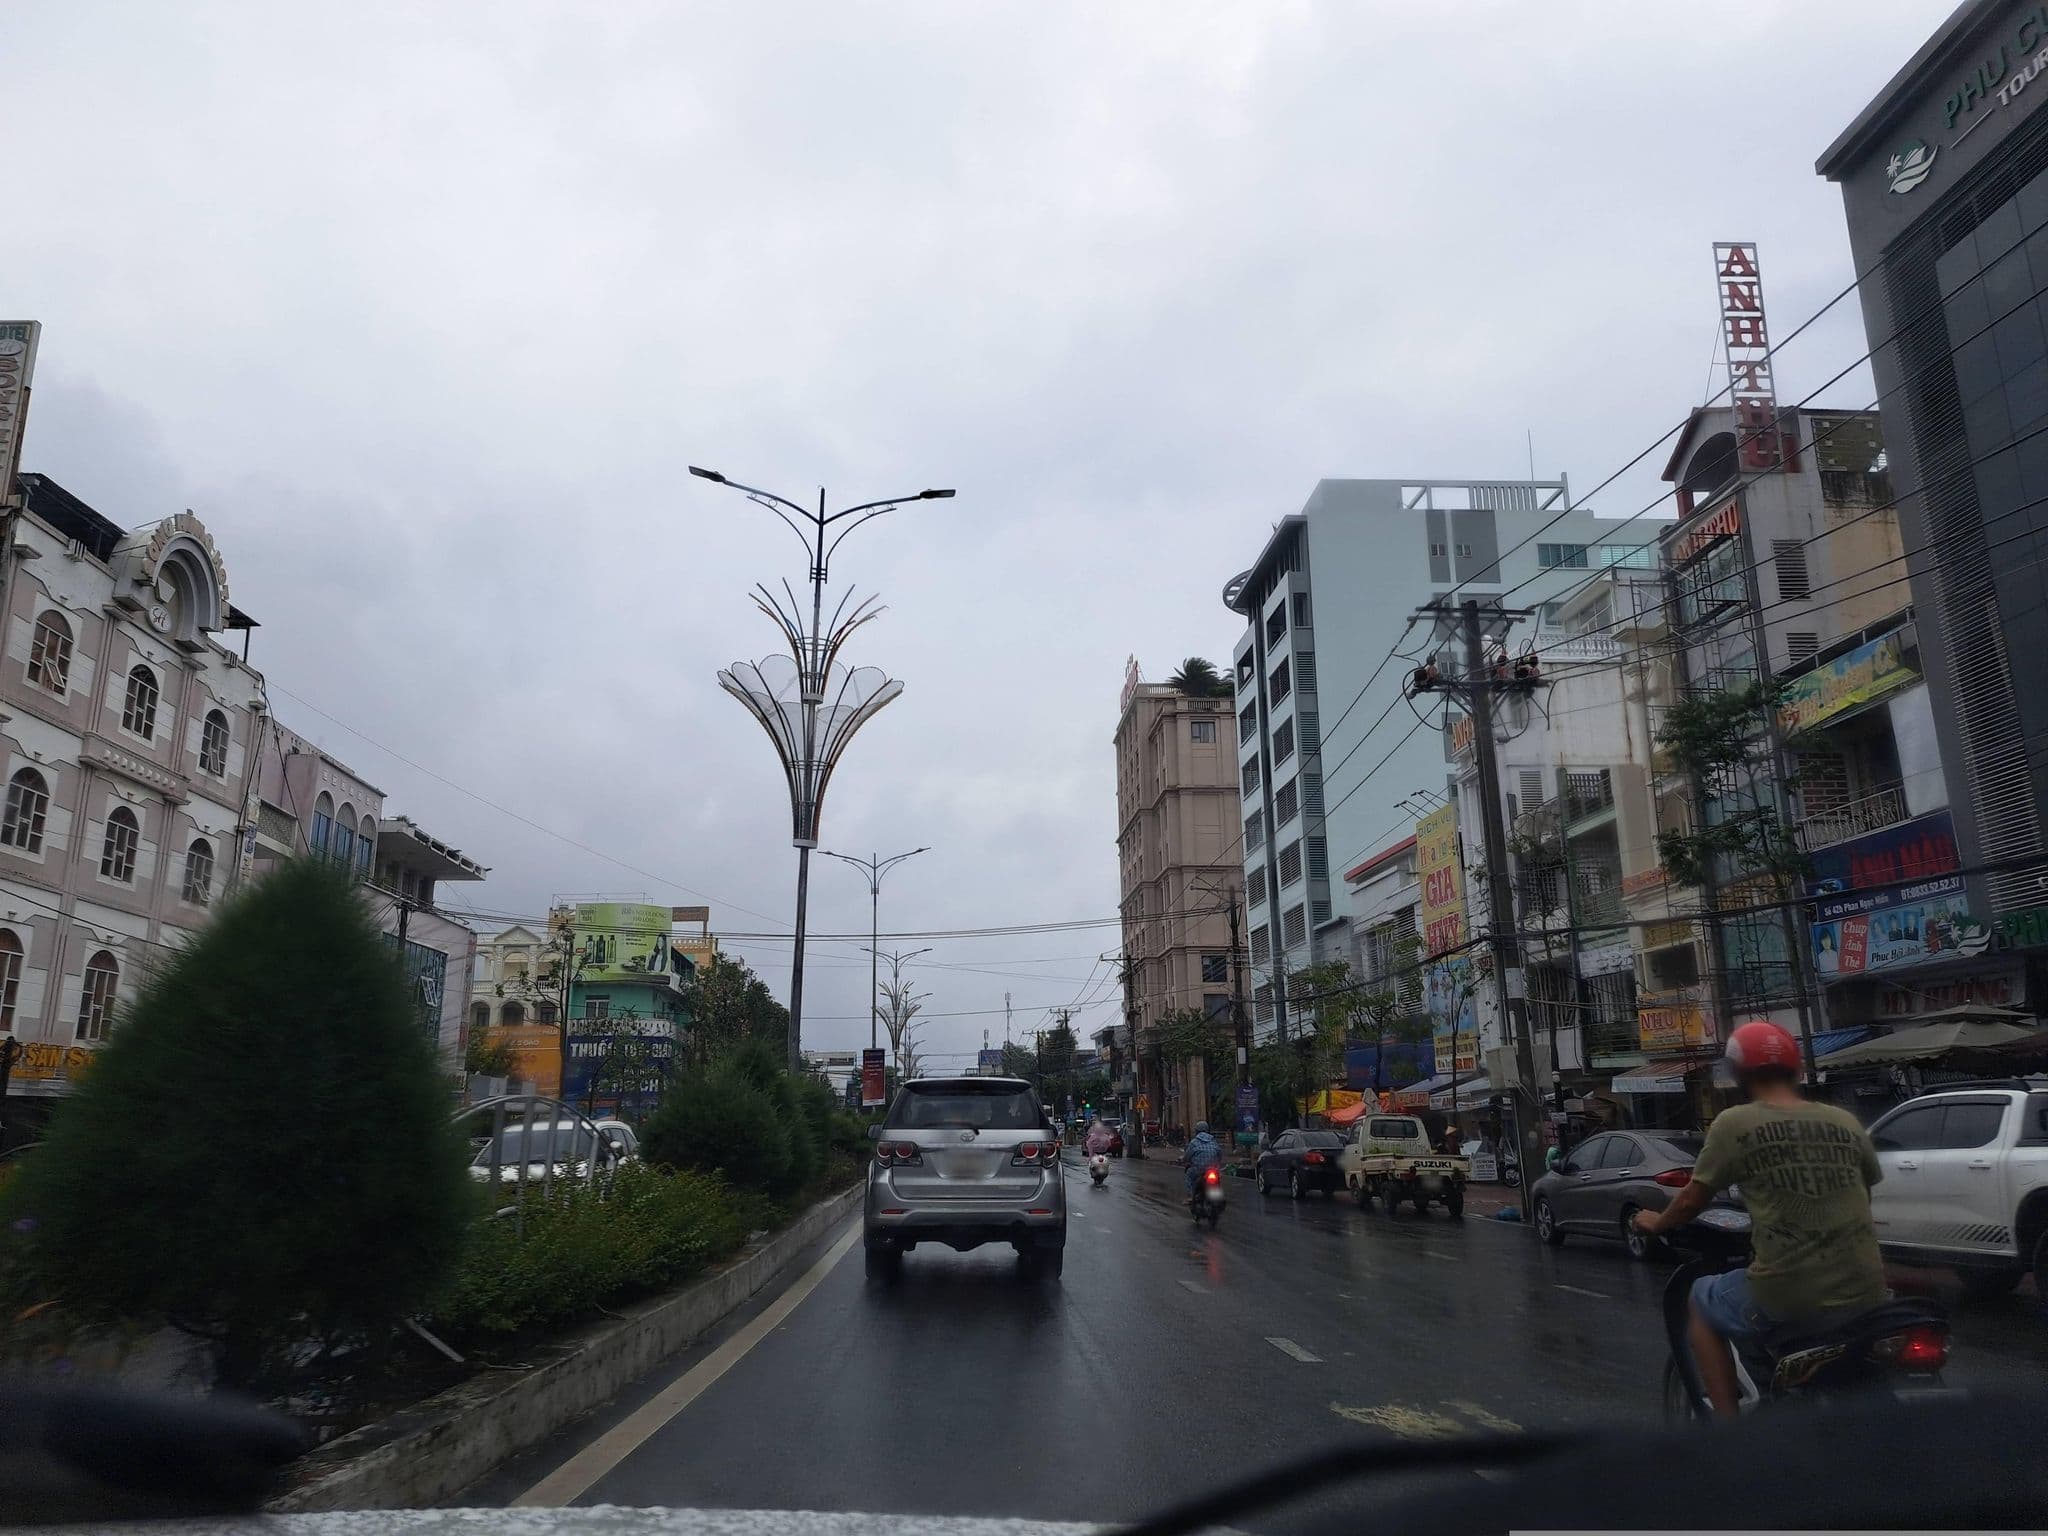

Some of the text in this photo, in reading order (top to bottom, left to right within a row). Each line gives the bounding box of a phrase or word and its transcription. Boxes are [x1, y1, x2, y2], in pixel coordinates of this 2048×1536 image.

[1719, 245, 1766, 347] ANH
[1755, 1120, 1800, 1144] RIDE
[1413, 1160, 1452, 1169] SUZUKI
[1769, 1167, 1812, 1195] LIVE
